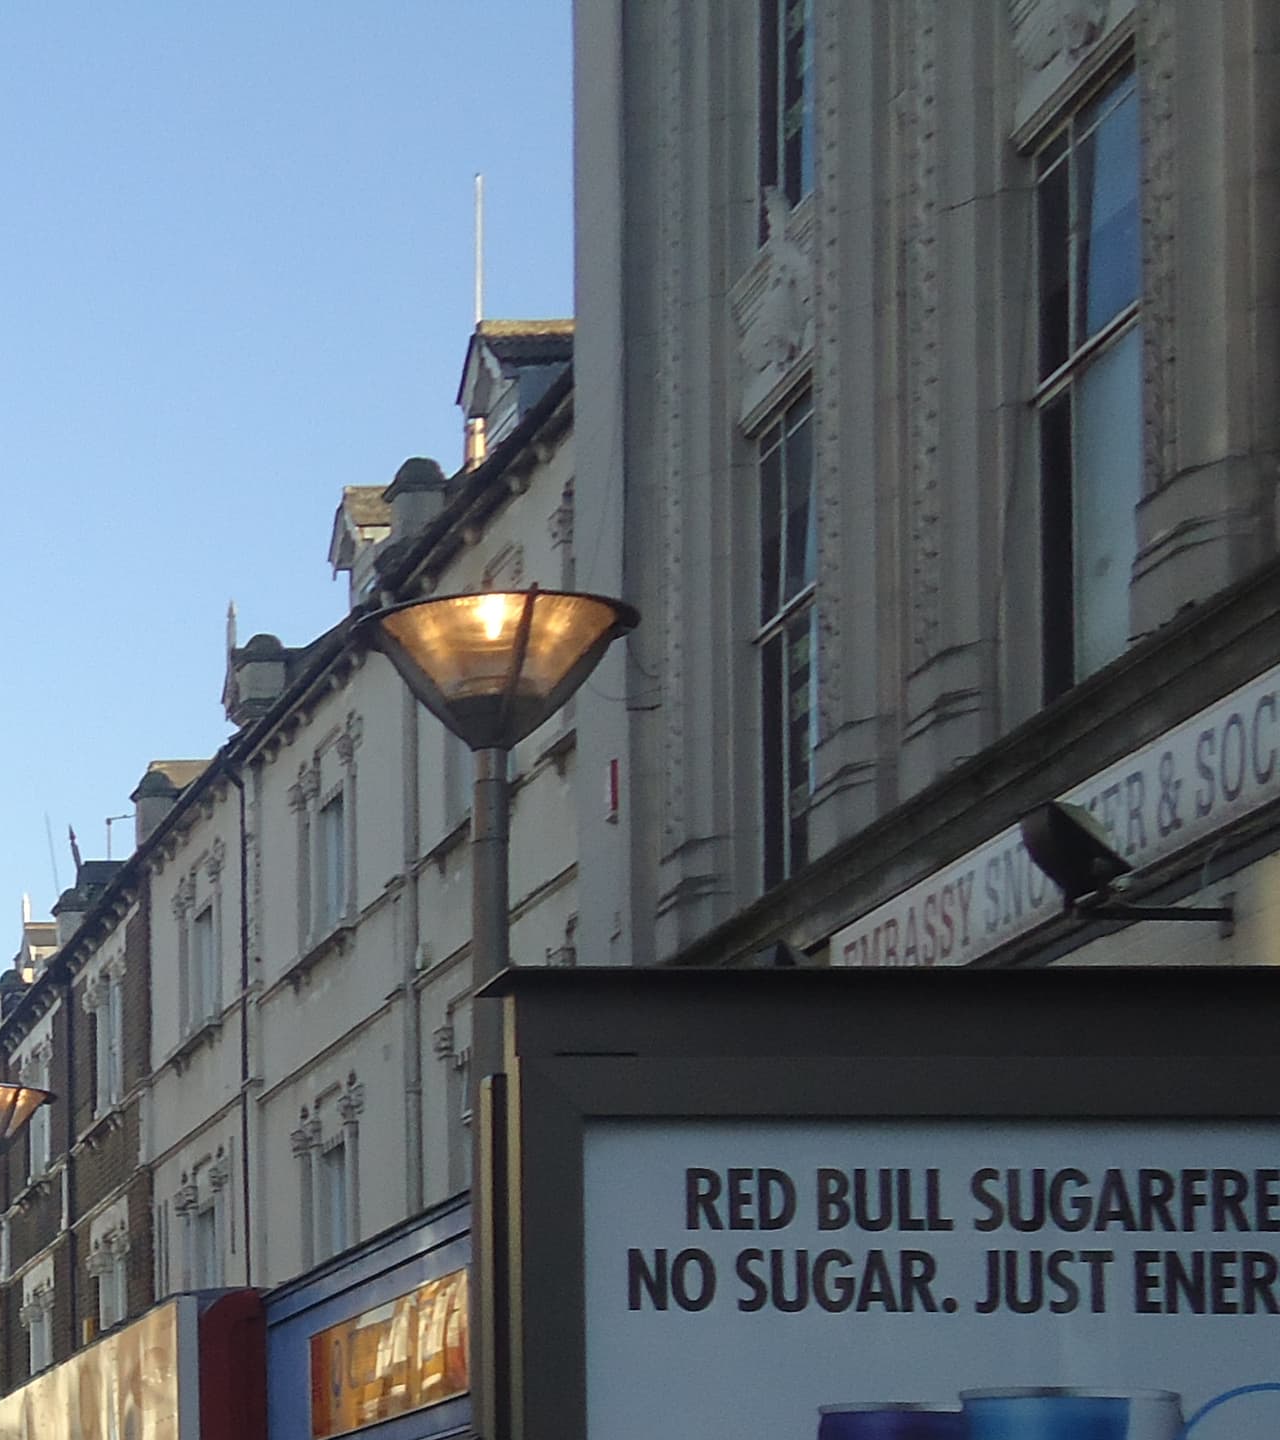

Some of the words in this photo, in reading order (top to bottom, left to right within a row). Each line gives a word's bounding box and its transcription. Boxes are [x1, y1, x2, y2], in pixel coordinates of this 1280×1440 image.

[985, 771, 1146, 933] SNOER
[1158, 751, 1183, 837] &
[685, 1167, 797, 1231] RED
[816, 1168, 953, 1232] BULL
[972, 1168, 1280, 1232] SUGARFRE
[627, 1247, 716, 1312] NO
[735, 1248, 958, 1313] SUGAR.
[974, 1250, 1114, 1314] JUST
[1133, 1250, 1280, 1315] ENER
